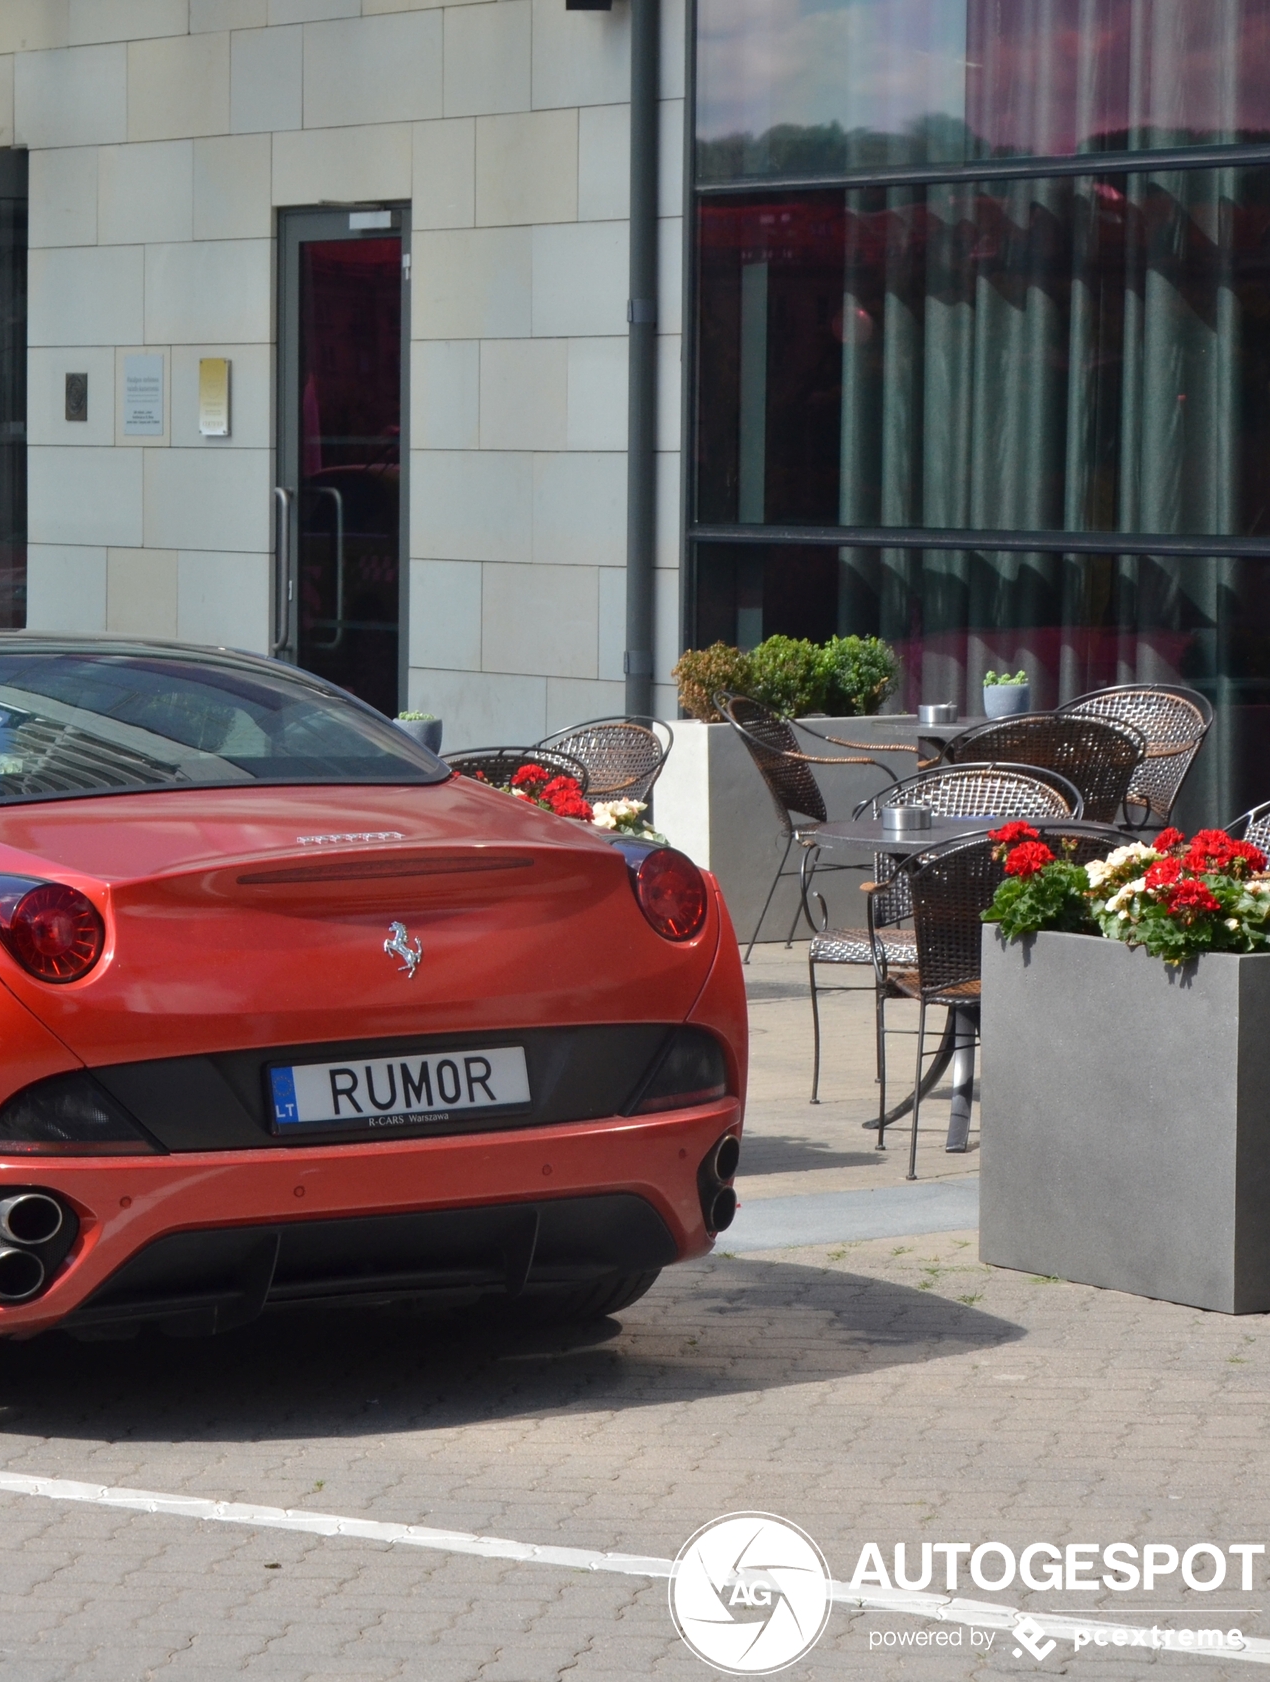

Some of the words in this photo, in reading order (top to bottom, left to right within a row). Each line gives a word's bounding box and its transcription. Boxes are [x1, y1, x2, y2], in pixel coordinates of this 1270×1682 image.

[329, 1056, 497, 1116] RUMOR
[276, 1103, 295, 1118] LT
[368, 1114, 405, 1127] R-CARS
[408, 1112, 449, 1124] Warszawa
